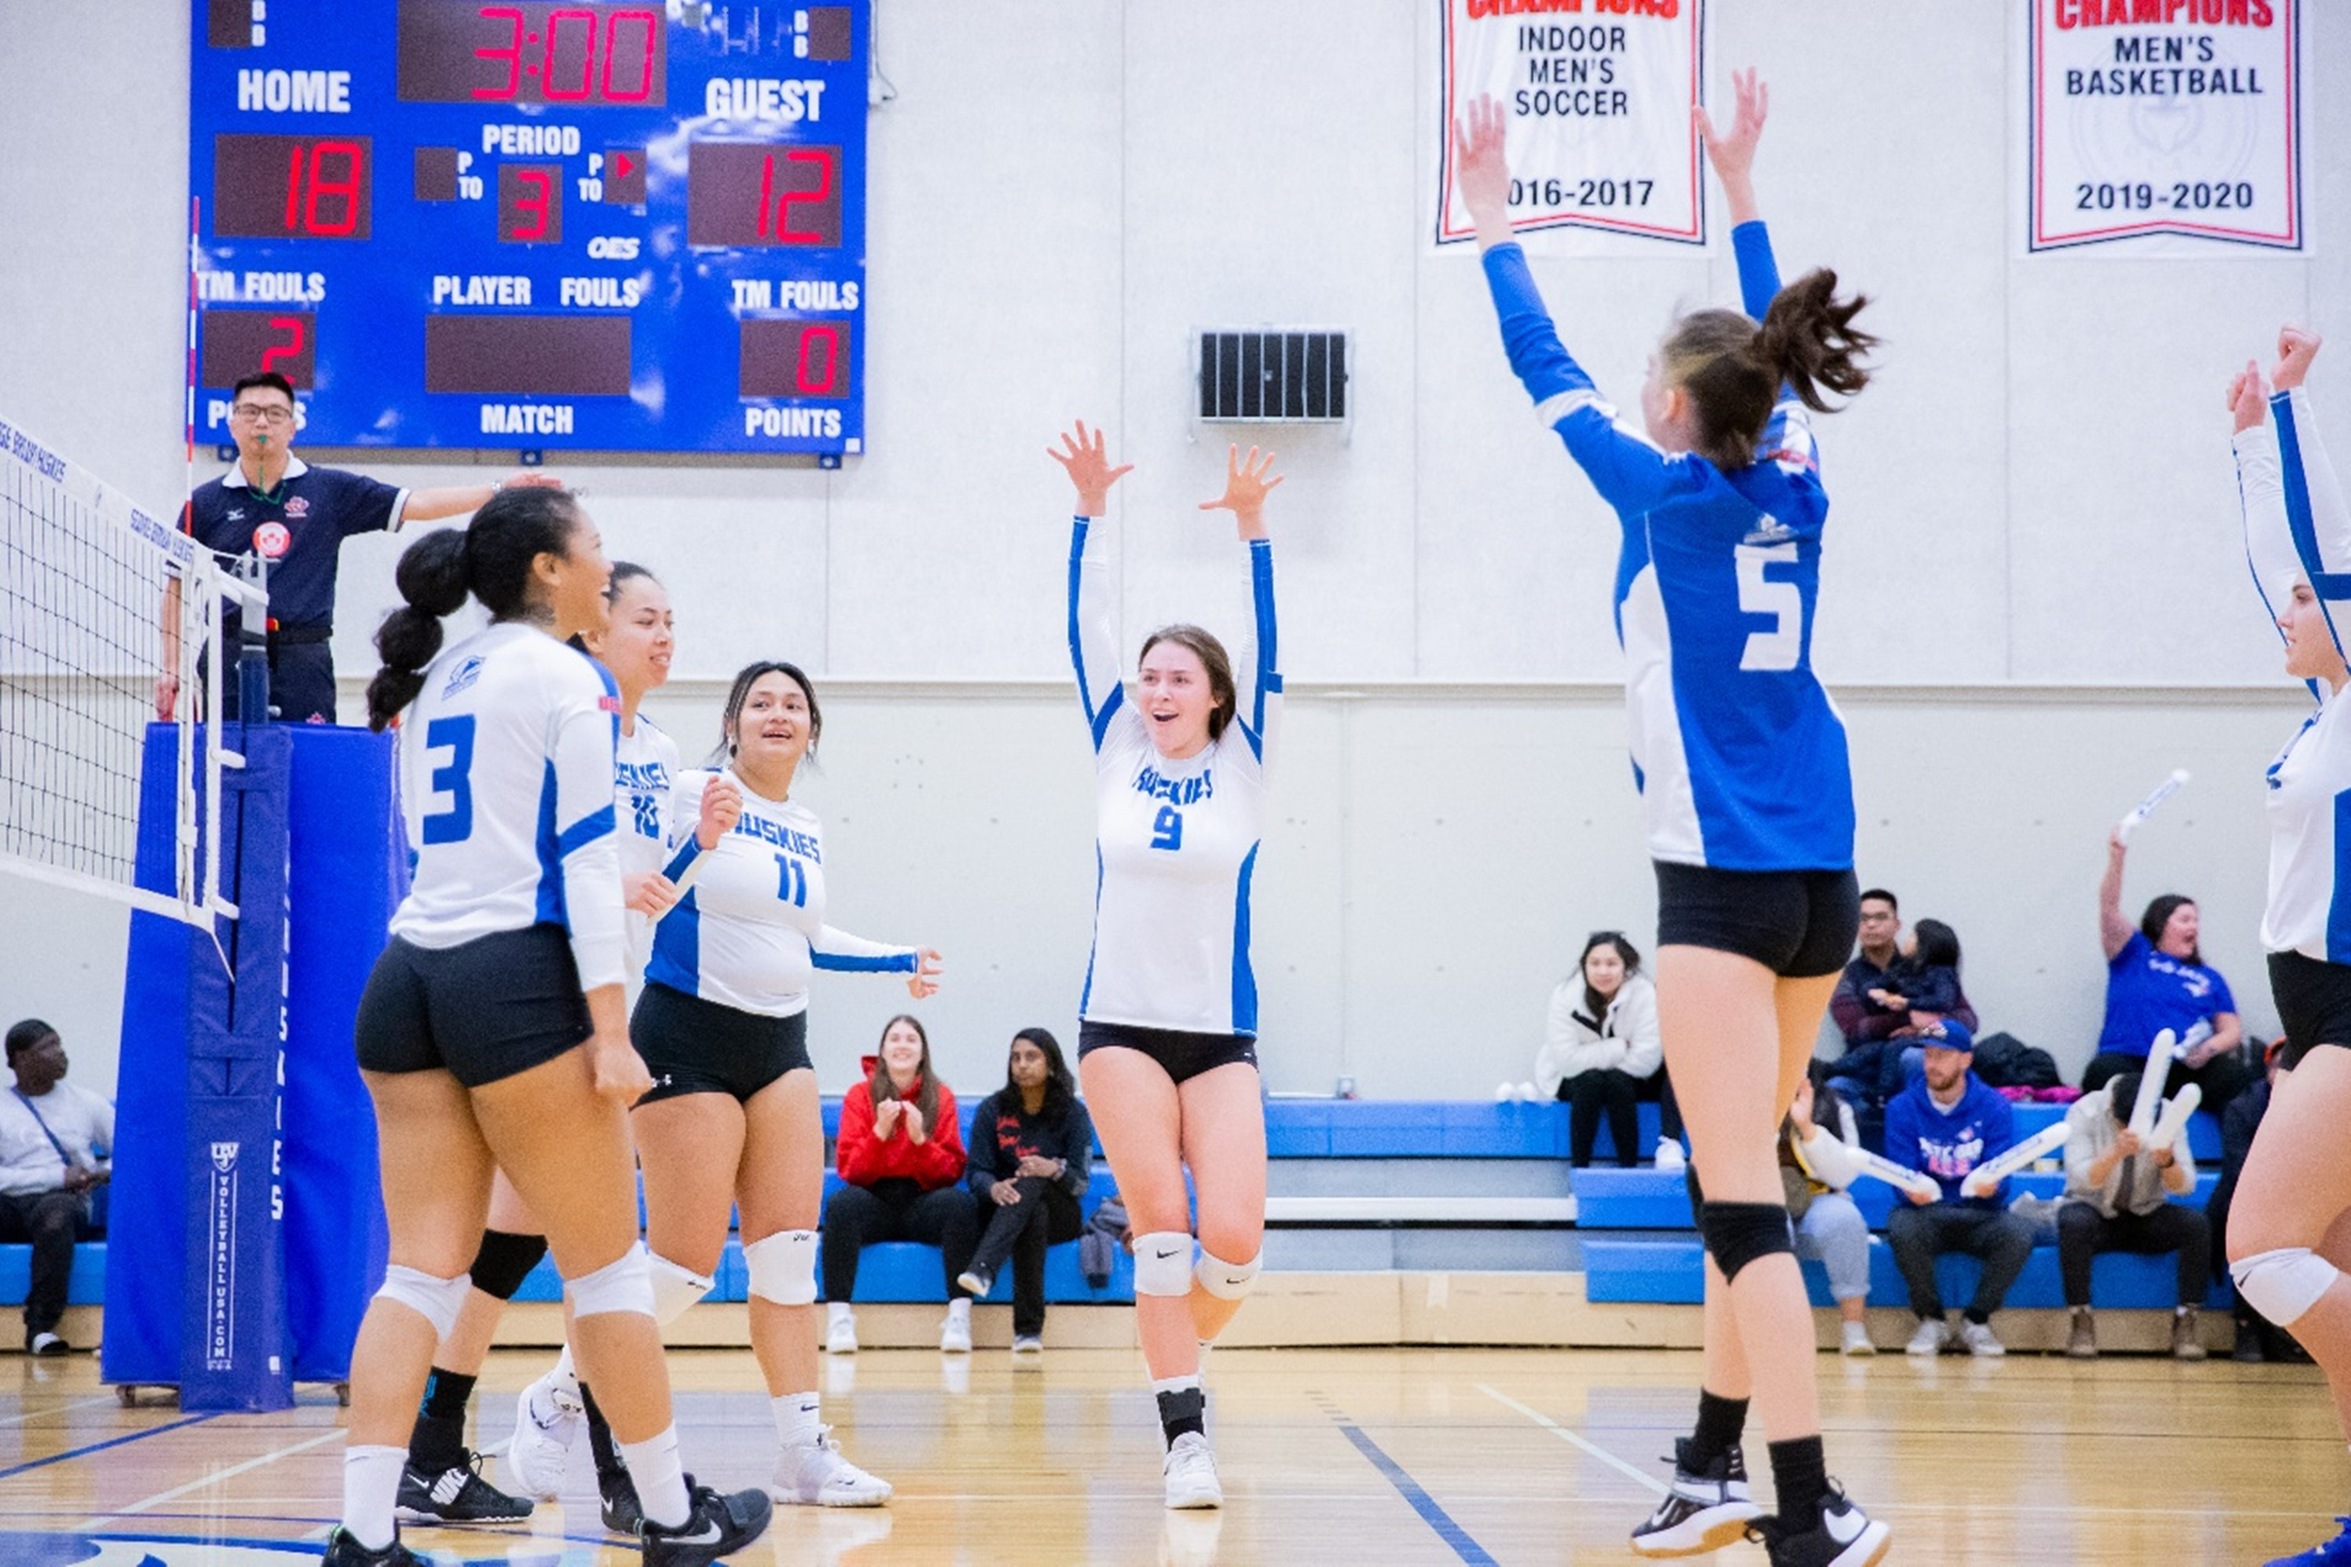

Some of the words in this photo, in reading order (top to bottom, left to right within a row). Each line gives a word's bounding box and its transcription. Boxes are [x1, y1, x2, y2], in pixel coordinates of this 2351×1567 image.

[471, 8, 656, 101] 3:00
[1519, 26, 1626, 52] INDOOR
[2115, 36, 2214, 63] MEN'S
[1530, 58, 1615, 84] MEN'S
[2067, 67, 2263, 95] BASKETBALL
[238, 68, 351, 113] HOME
[705, 77, 826, 122] GUEST
[1516, 90, 1628, 116] SOCCER
[482, 124, 581, 155] PERIOD
[457, 151, 473, 174] P
[588, 153, 604, 176] P
[285, 141, 363, 235] 18
[459, 176, 484, 200] TO
[577, 178, 602, 202] TO
[757, 151, 832, 243] 12
[1508, 179, 1653, 206] 016-2017
[2077, 183, 2254, 210] 2019-2020
[512, 170, 551, 240] 3
[587, 237, 641, 260] OES
[196, 271, 235, 300] TM
[245, 271, 326, 302] FOULS
[433, 275, 532, 305] PLAYER
[560, 277, 640, 308] FOULS
[731, 279, 771, 308] TM
[780, 280, 859, 310] FOULS
[261, 317, 303, 385] 2
[797, 327, 838, 393] 0
[481, 404, 574, 434] MATCH
[745, 408, 841, 438] POINTS
[1734, 541, 1802, 671] 5
[423, 713, 476, 846] 3
[631, 794, 659, 840] 10
[1150, 805, 1183, 851] 9
[774, 852, 807, 909] 11
[430, 1467, 469, 1506] NIKE
